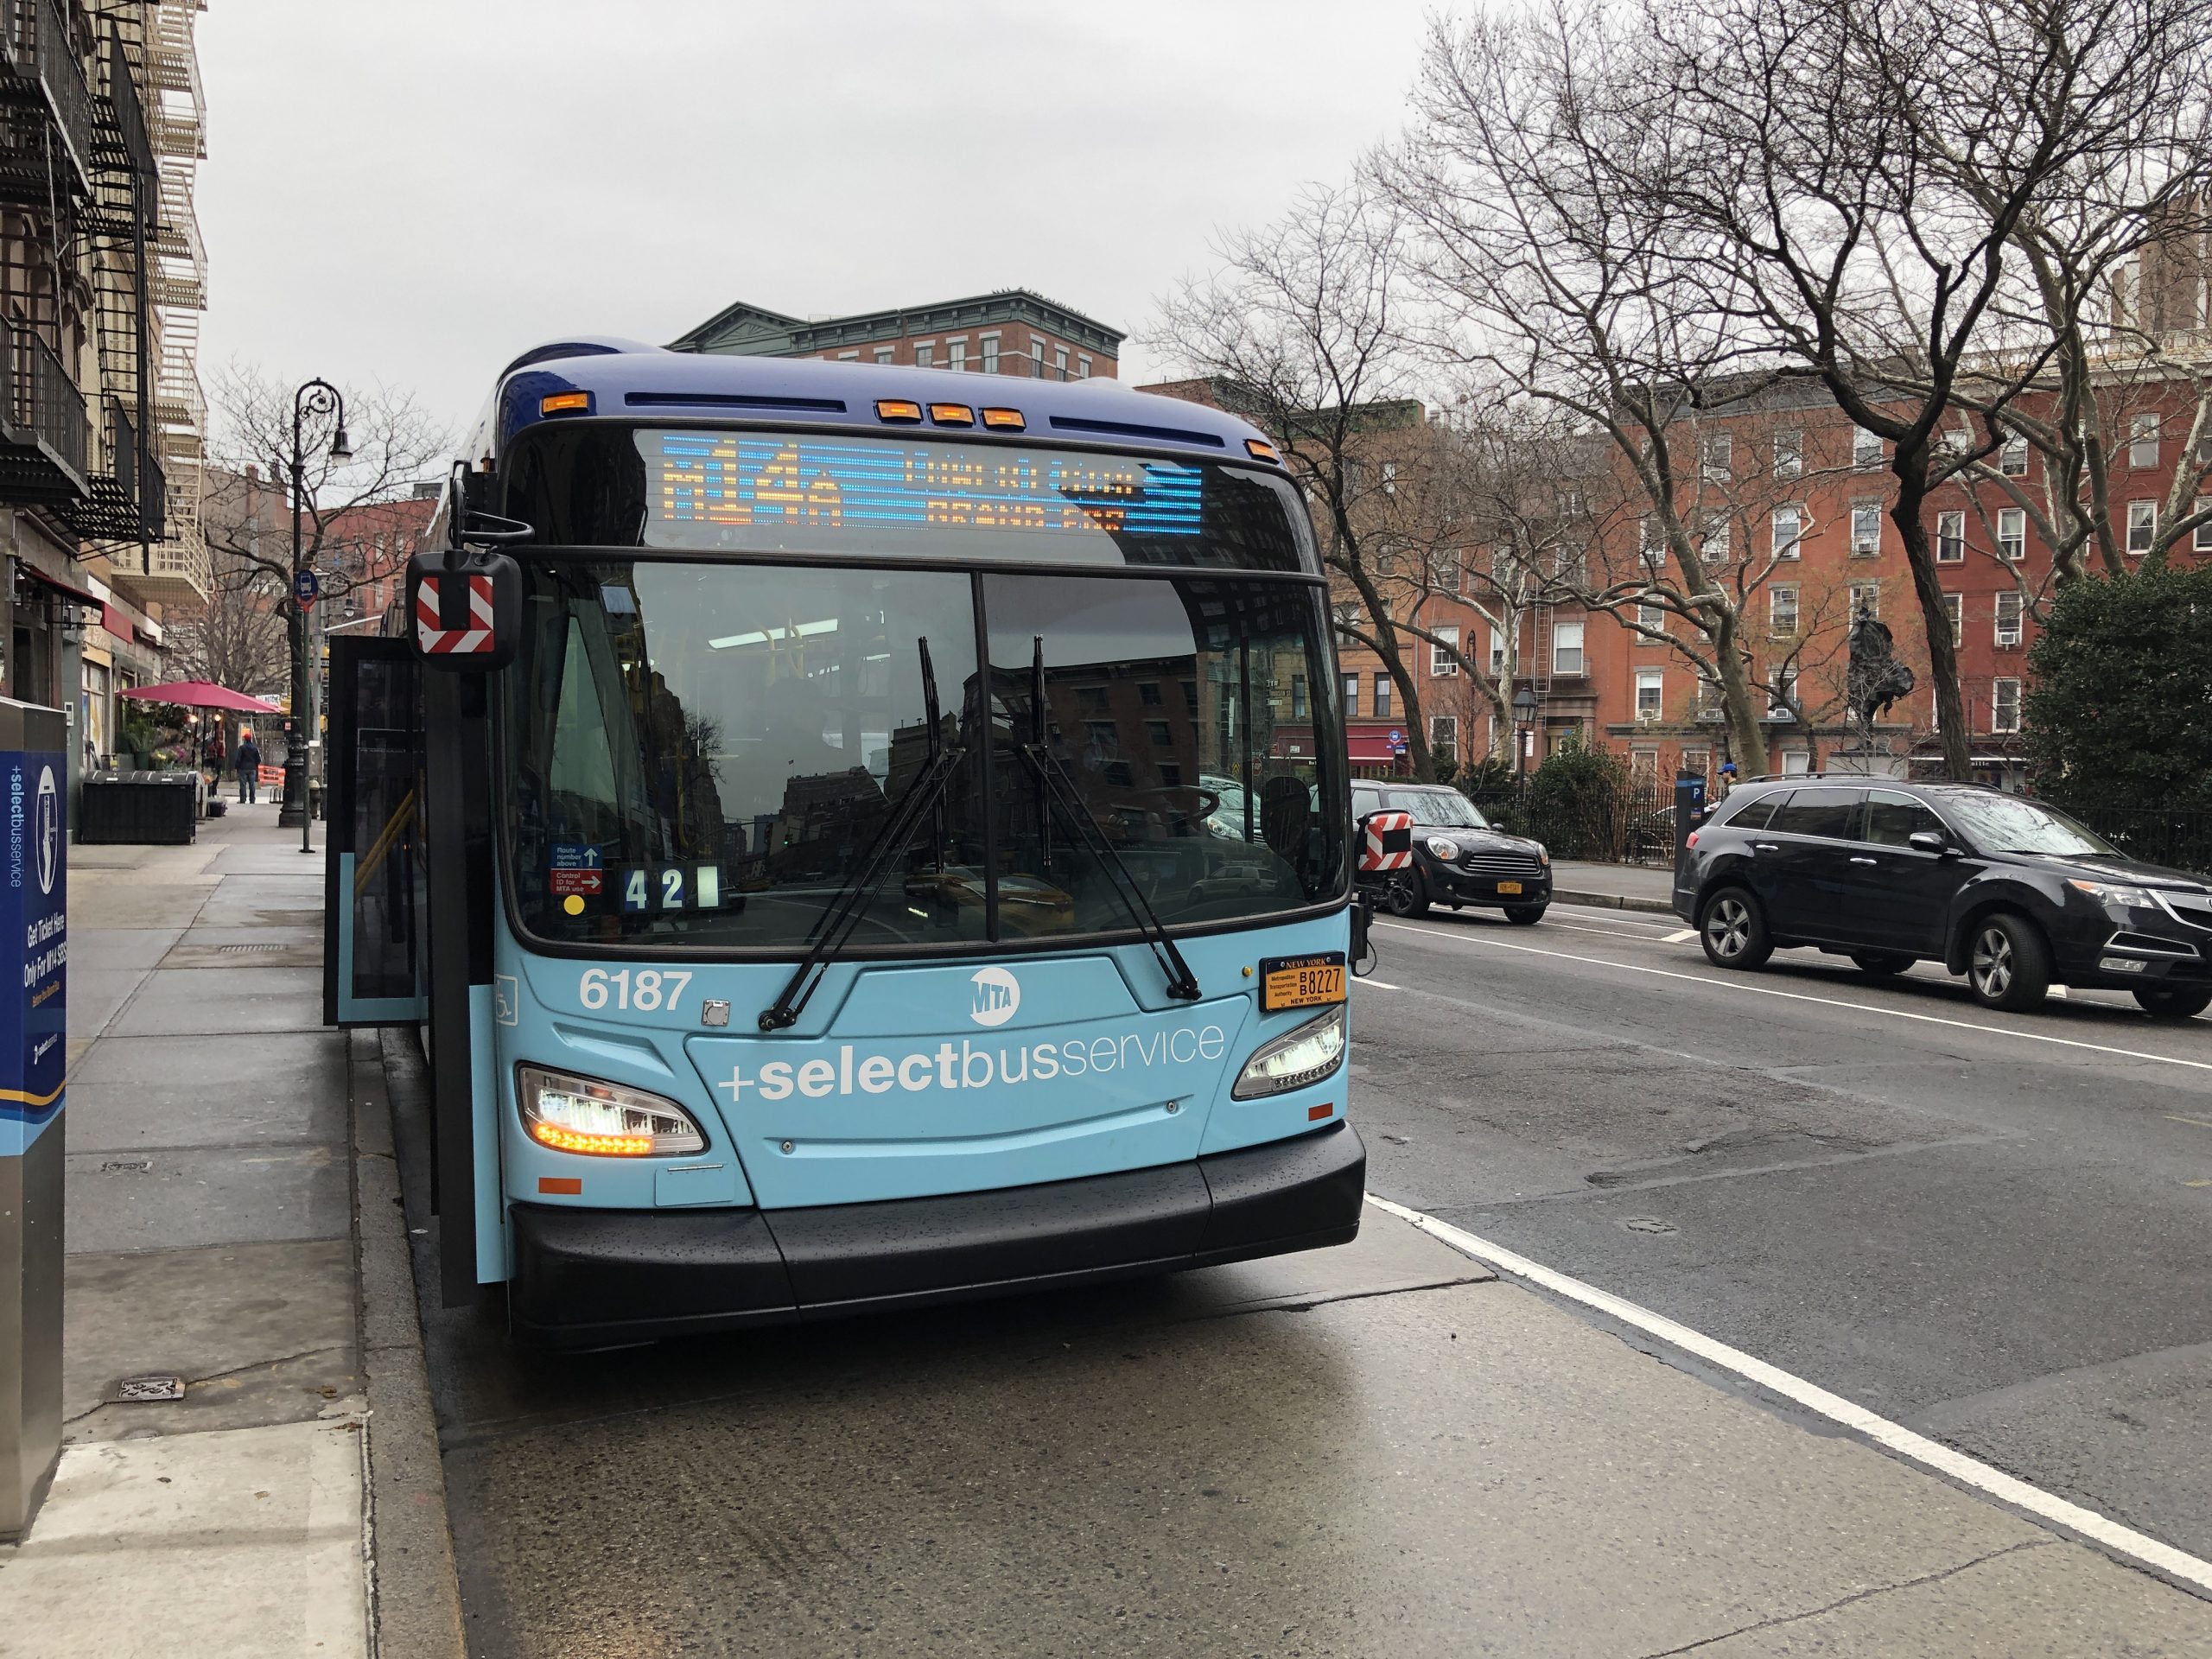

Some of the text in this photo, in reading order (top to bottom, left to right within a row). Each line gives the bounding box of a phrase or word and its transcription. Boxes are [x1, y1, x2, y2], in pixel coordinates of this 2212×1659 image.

[1694, 787, 1700, 798] P
[28, 912, 65, 949] Get Ticket Here
[24, 960, 36, 988] Only
[37, 956, 46, 979] For
[1286, 957, 1327, 969] NEW YORK
[580, 968, 693, 1011] 6187
[972, 980, 1013, 1014] MTA
[1308, 968, 1341, 995] 8227
